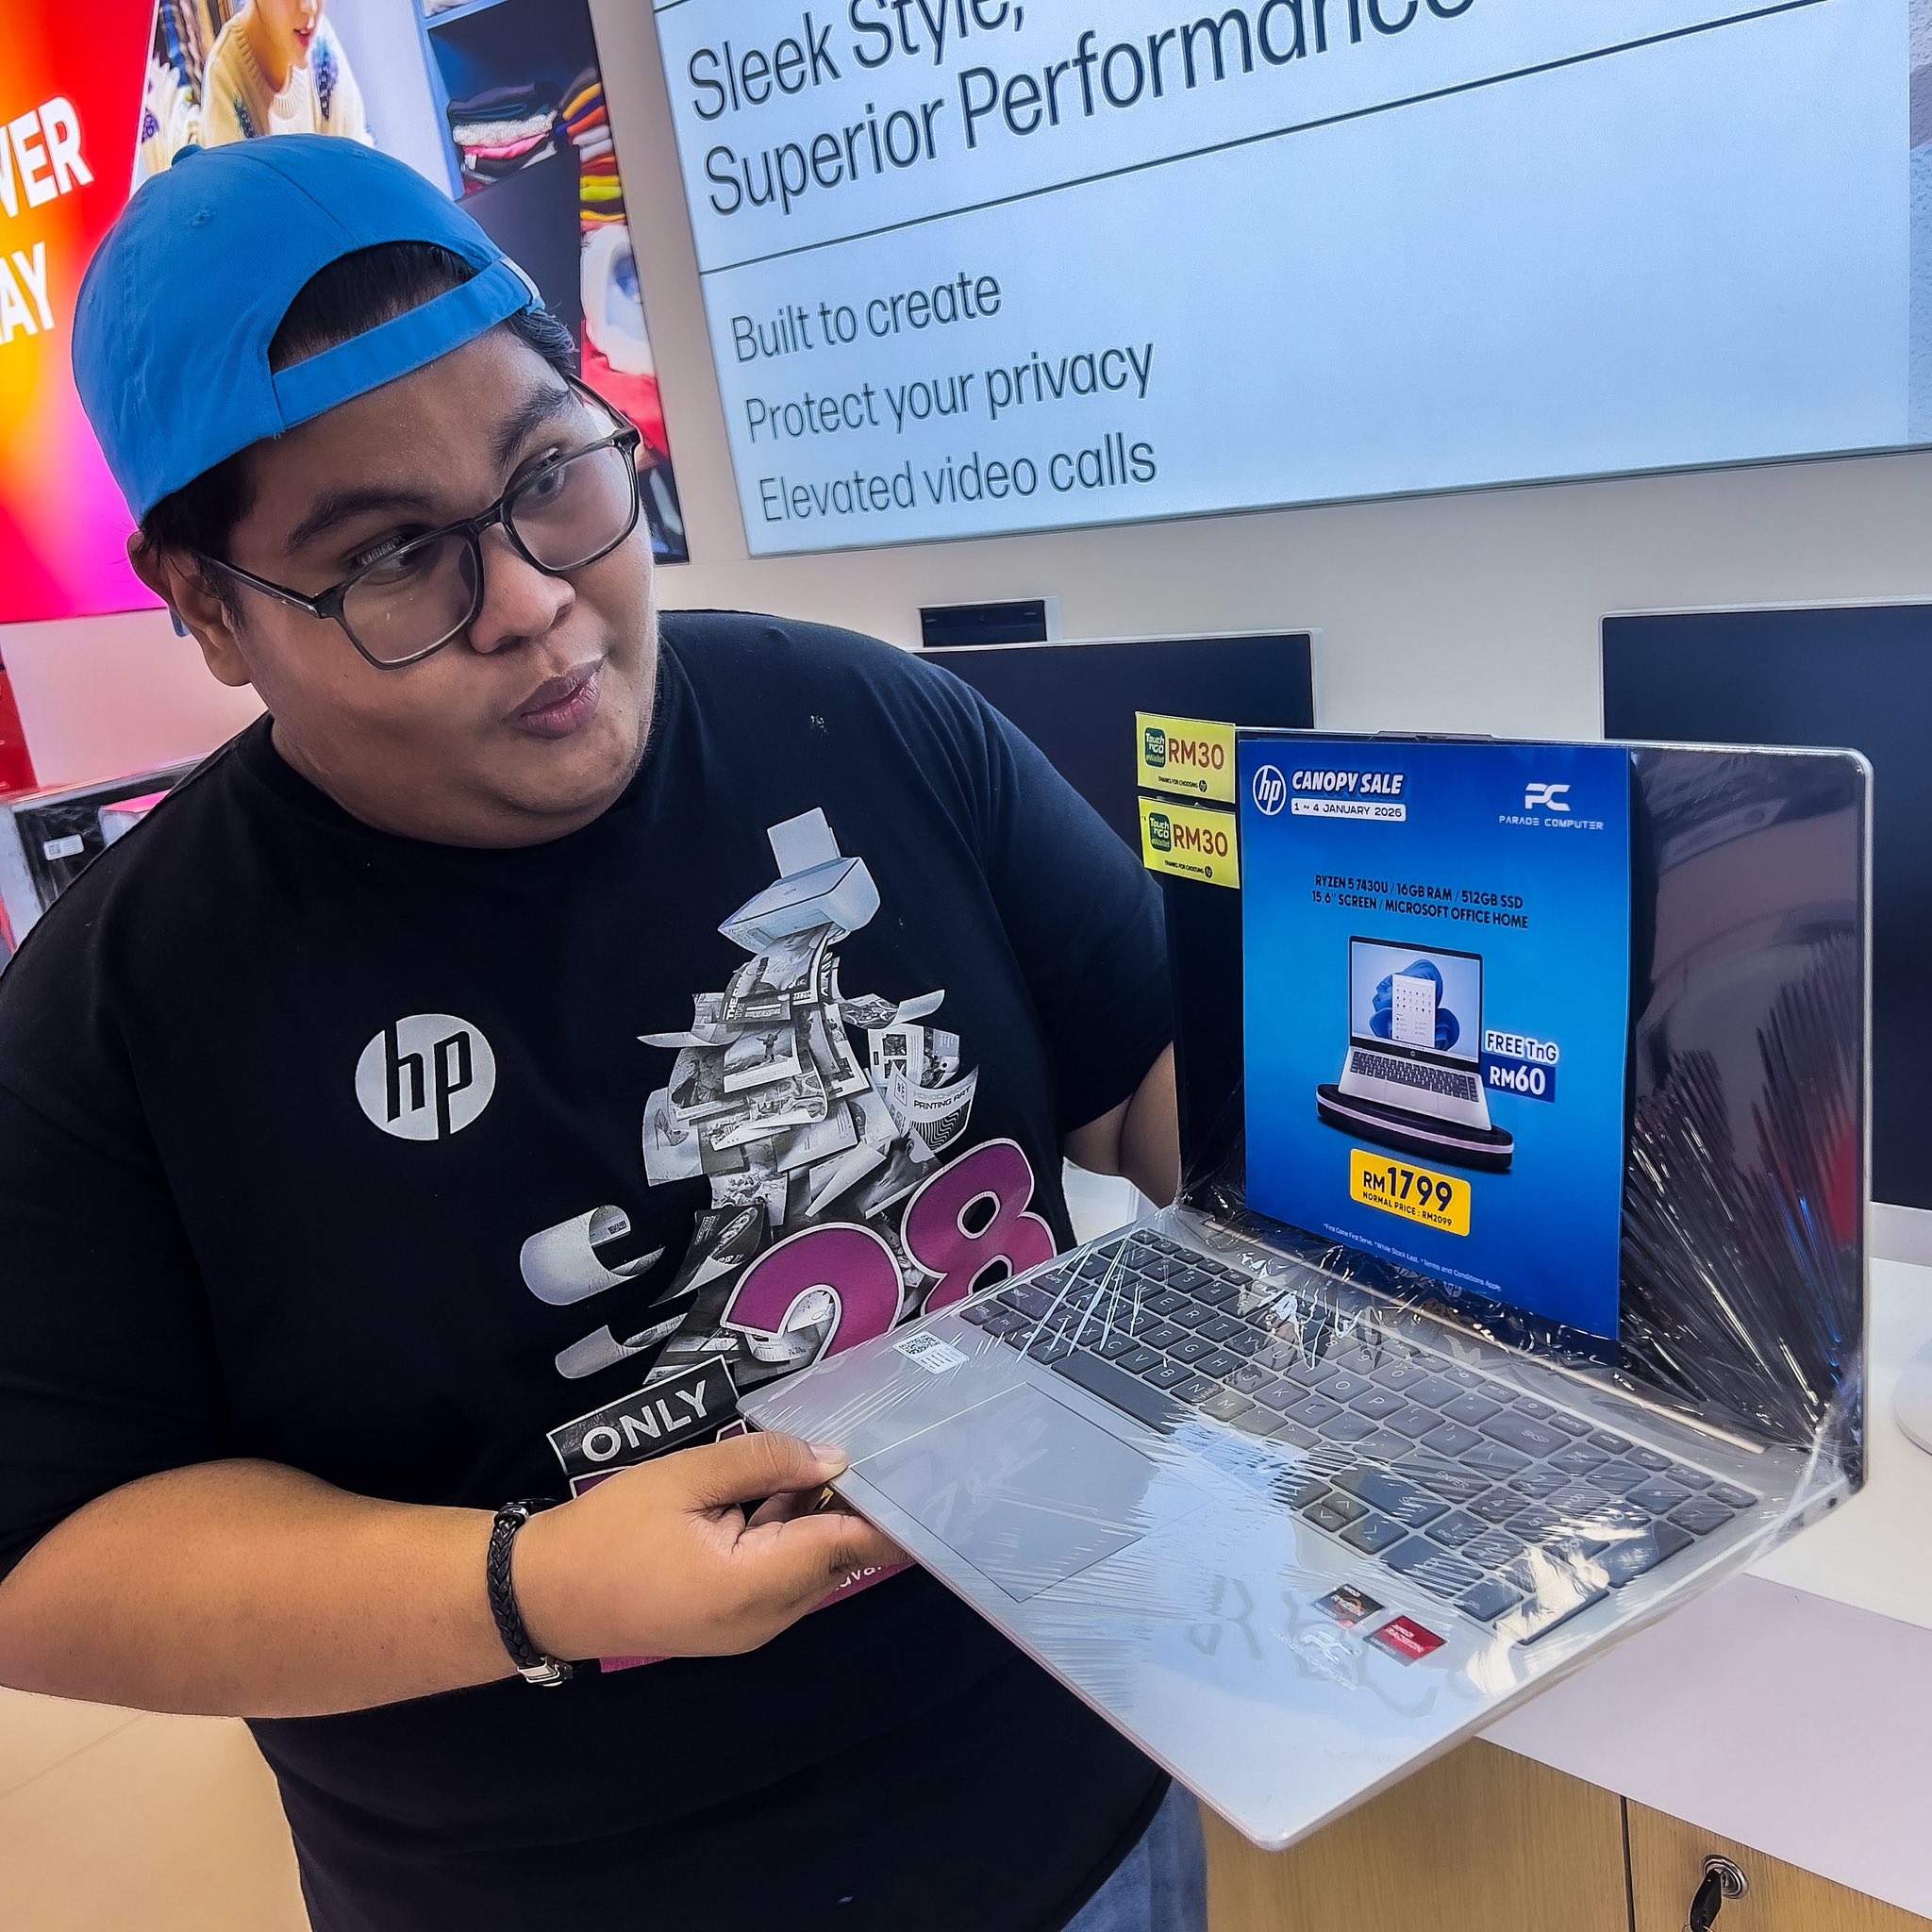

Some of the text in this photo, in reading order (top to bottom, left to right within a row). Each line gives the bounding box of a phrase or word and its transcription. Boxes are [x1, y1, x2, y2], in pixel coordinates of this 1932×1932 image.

[689, 11, 841, 121] Sleek
[706, 0, 1474, 215] Superior Performan
[730, 272, 1003, 363] Built to create
[745, 343, 1154, 443] Protect your privacy
[759, 432, 1158, 523] Elevated video calls
[1168, 738, 1224, 770] RM30
[1255, 766, 1284, 814] hp
[1292, 771, 1404, 794] CANOPY SALE
[1524, 783, 1571, 811] PC
[1294, 803, 1300, 811] 1
[1323, 804, 1370, 815] JANUARY
[1374, 807, 1402, 818] 2026
[1499, 815, 1604, 830] PARADE COMPUTER
[1173, 824, 1228, 857] RM30
[1315, 874, 1346, 890] RYZEN
[1348, 878, 1354, 890] 5
[1356, 878, 1389, 894] 7430U
[1396, 883, 1424, 898] 16GB
[1427, 886, 1452, 901] RAM
[1461, 891, 1497, 907] 512GB
[1500, 895, 1524, 909] SSD
[1338, 892, 1377, 910] SCREEN
[1385, 899, 1449, 919] MICROSOFT
[1450, 908, 1491, 924] OFFICE
[1492, 913, 1528, 929] HOME
[1488, 1033, 1557, 1061] FREE TnG
[371, 1016, 484, 1141] hp
[1490, 1065, 1545, 1095] RM60
[913, 1085, 972, 1110] PRINTING ART
[1363, 1167, 1453, 1211] RM1799
[1362, 1191, 1392, 1208] NORMAL
[1394, 1202, 1416, 1216] PRICE
[1422, 1210, 1453, 1226] RM2099
[1336, 1227, 1348, 1237] Come
[1391, 1247, 1406, 1258] Stock
[1441, 1266, 1453, 1274] and
[1453, 1270, 1485, 1285] Conditions
[1159, 1297, 1174, 1307] E
[1185, 1309, 1200, 1319] R
[1082, 1326, 1097, 1336] X
[1157, 1329, 1172, 1338] F
[1215, 1323, 1229, 1331] T
[1108, 1341, 1122, 1349] C
[1184, 1343, 1199, 1353] G
[1243, 1336, 1257, 1344] Y
[1135, 1354, 1149, 1362] V
[1210, 1357, 1228, 1367] H
[1272, 1350, 1288, 1359] U
[1159, 1368, 1175, 1377] B
[1188, 1383, 1206, 1393] N
[1273, 1388, 1290, 1398] K
[1335, 1380, 1351, 1391] O
[1217, 1399, 1236, 1409] M
[1305, 1405, 1317, 1415] L
[1368, 1396, 1385, 1407] P
[581, 1379, 708, 1462] ONLY
